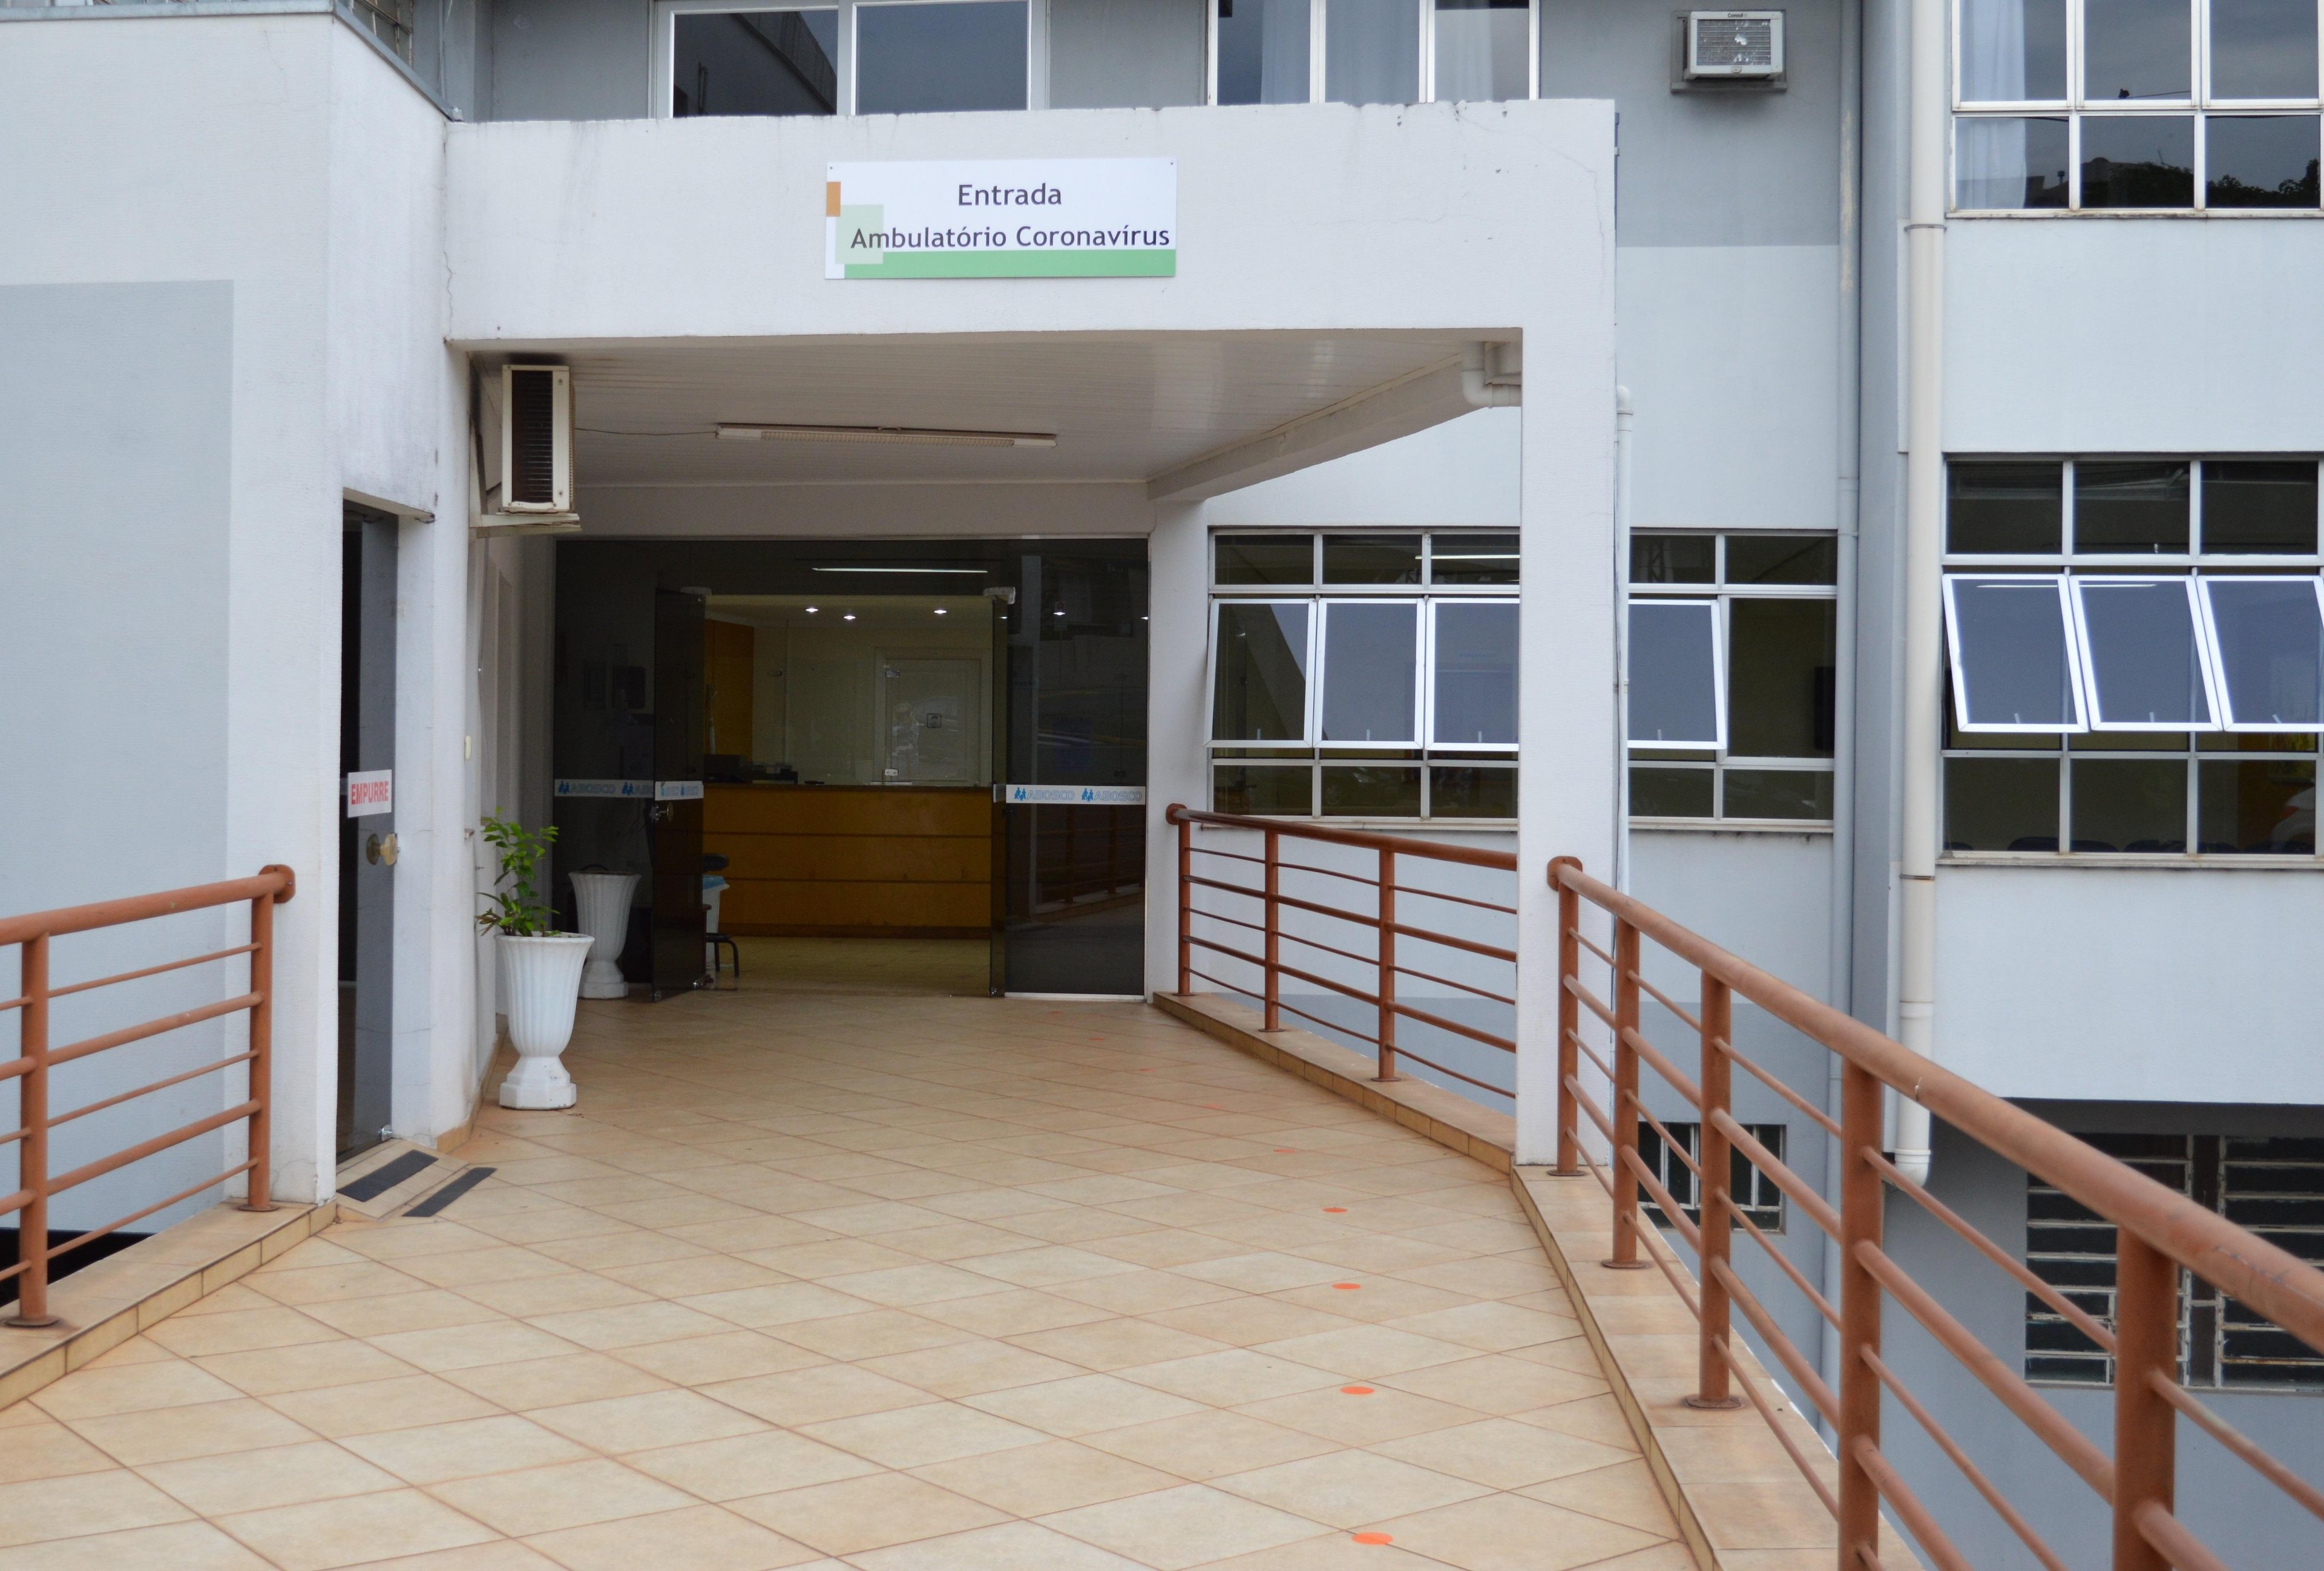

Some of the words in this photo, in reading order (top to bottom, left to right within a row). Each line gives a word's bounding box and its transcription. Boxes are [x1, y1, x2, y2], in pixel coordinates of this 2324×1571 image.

[958, 183, 1062, 206] Entrada
[851, 227, 1006, 249] Ambulatório
[1016, 225, 1170, 246] Coronavírus
[351, 781, 389, 805] EMPURRE
[1027, 790, 1075, 800] ABOSCO
[1094, 791, 1143, 801] ABOSCO
